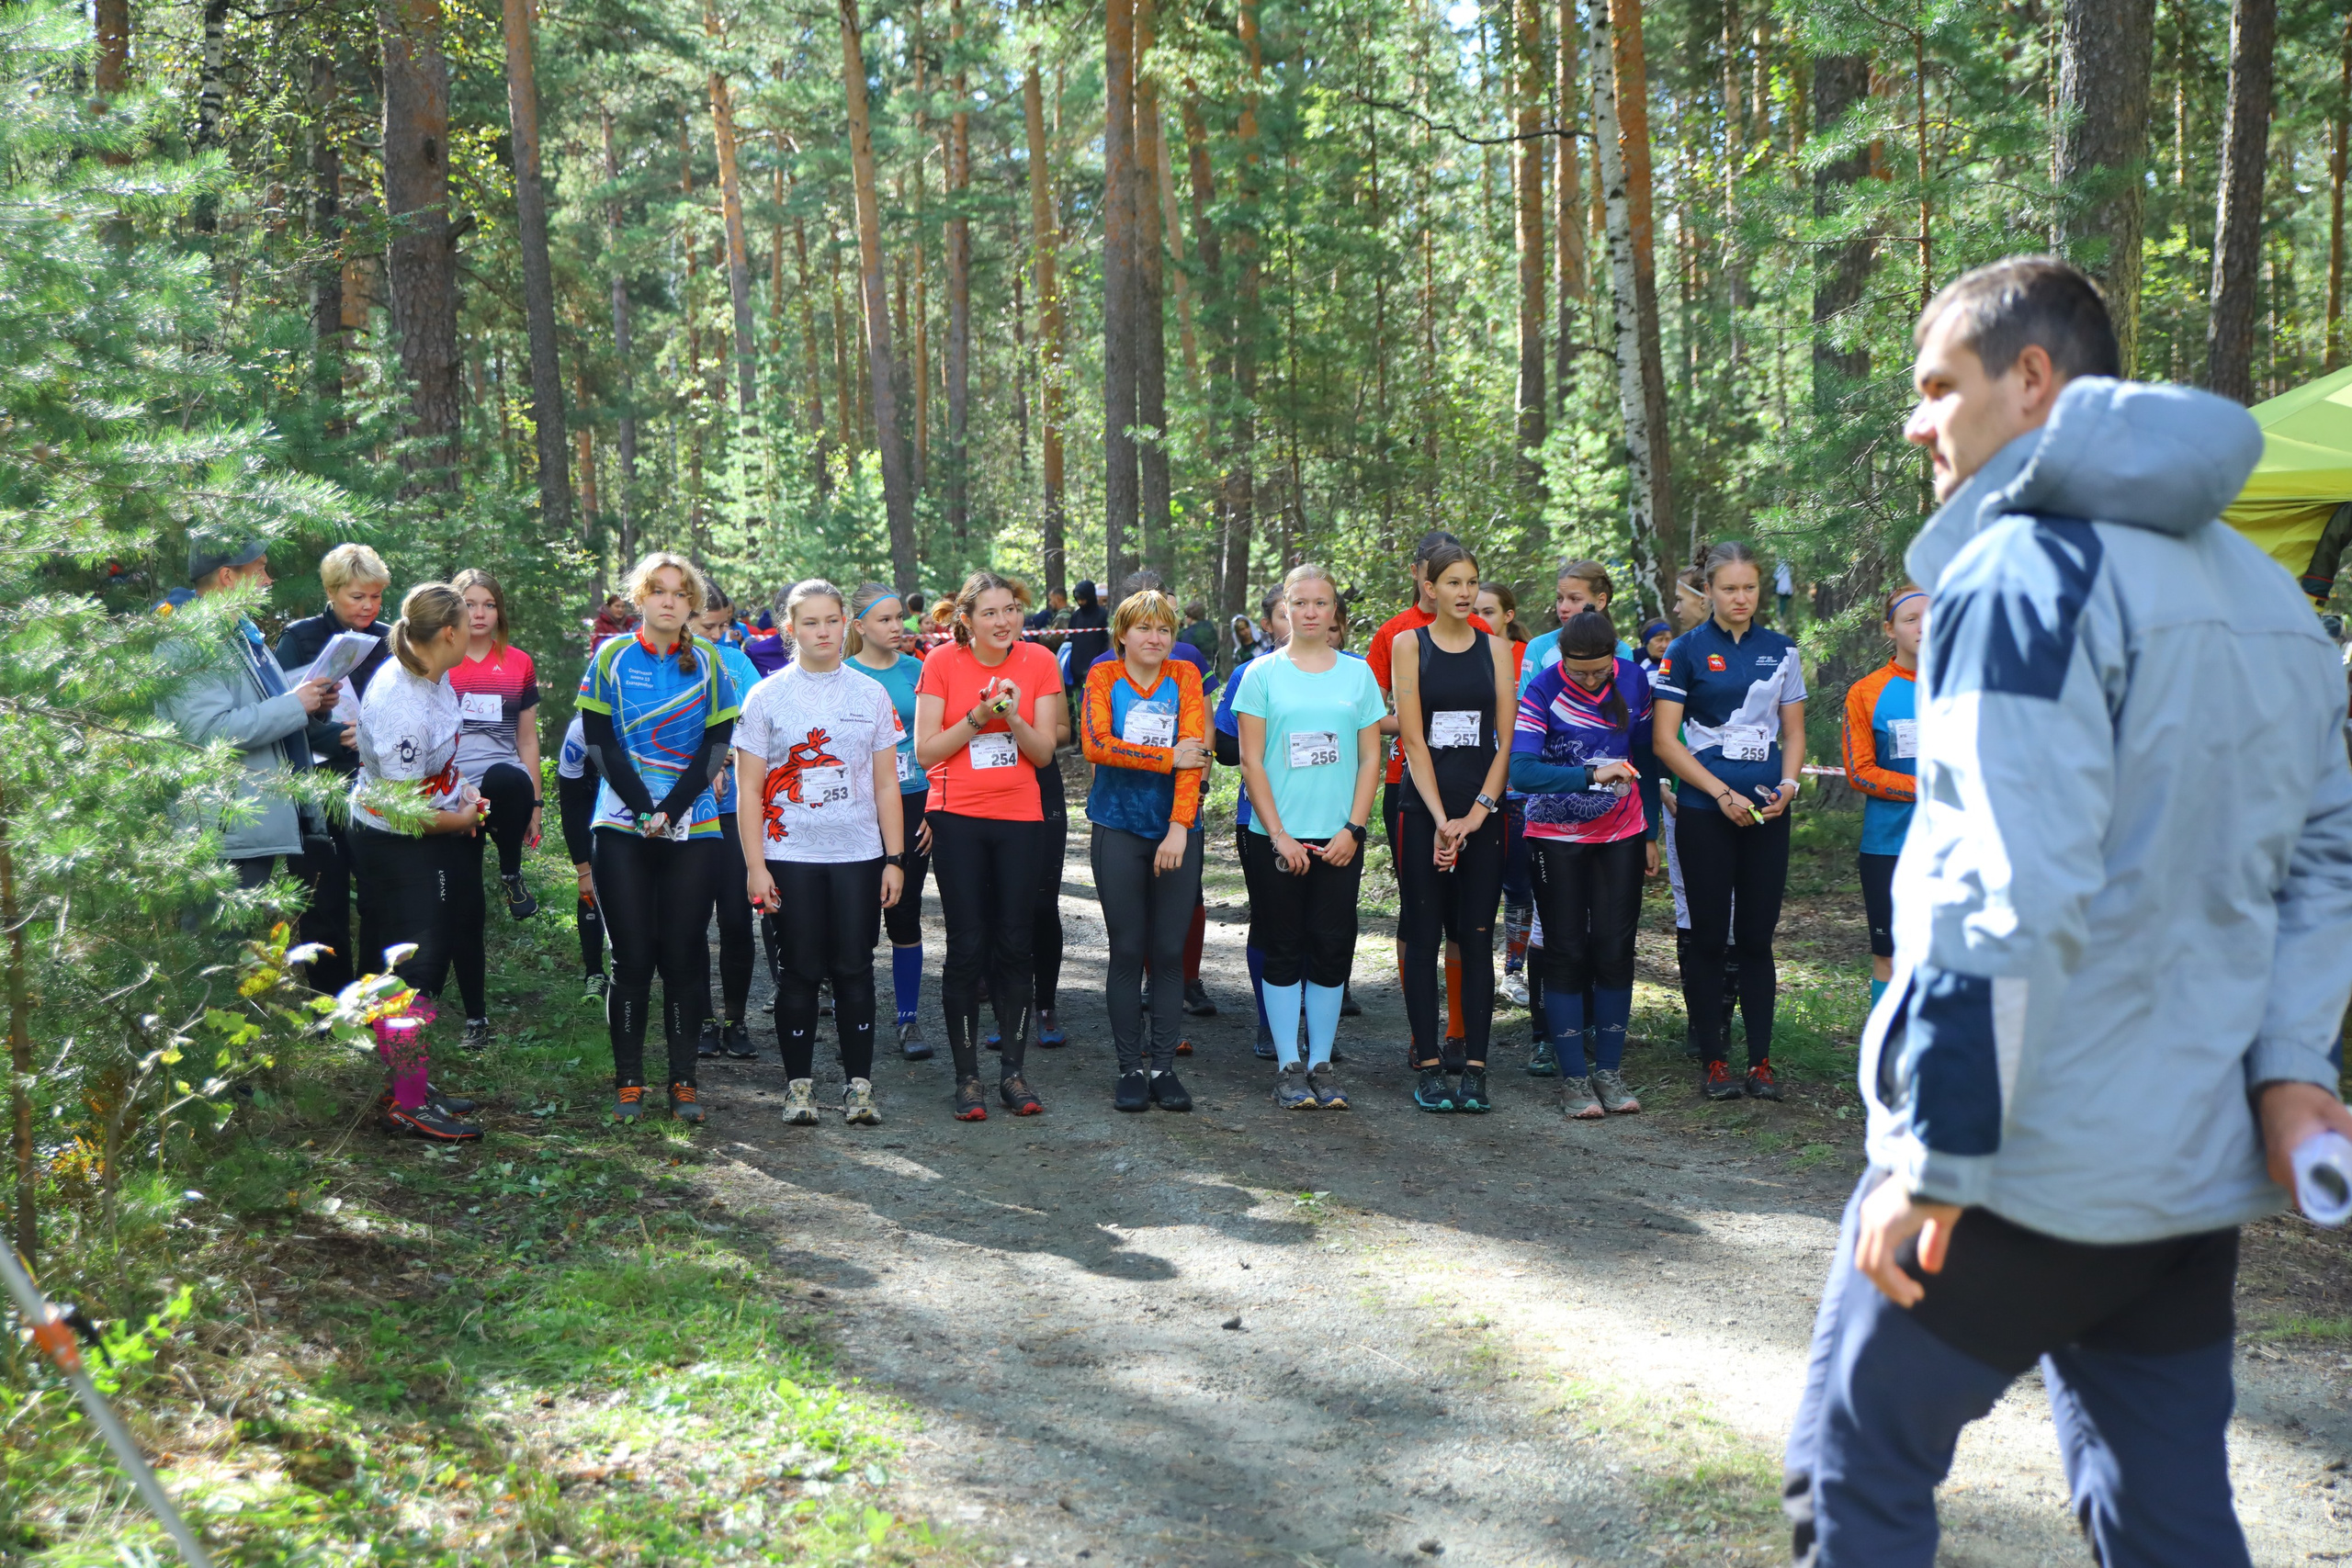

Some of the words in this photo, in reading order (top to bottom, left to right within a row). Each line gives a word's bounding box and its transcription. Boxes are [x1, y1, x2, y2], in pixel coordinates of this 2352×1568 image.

[464, 700, 495, 714] 261
[1142, 735, 1168, 747] 255
[1453, 733, 1477, 746] 257
[991, 752, 1016, 766] 254
[1310, 750, 1337, 765] 256
[1741, 747, 1765, 761] 259
[823, 786, 848, 802] 253
